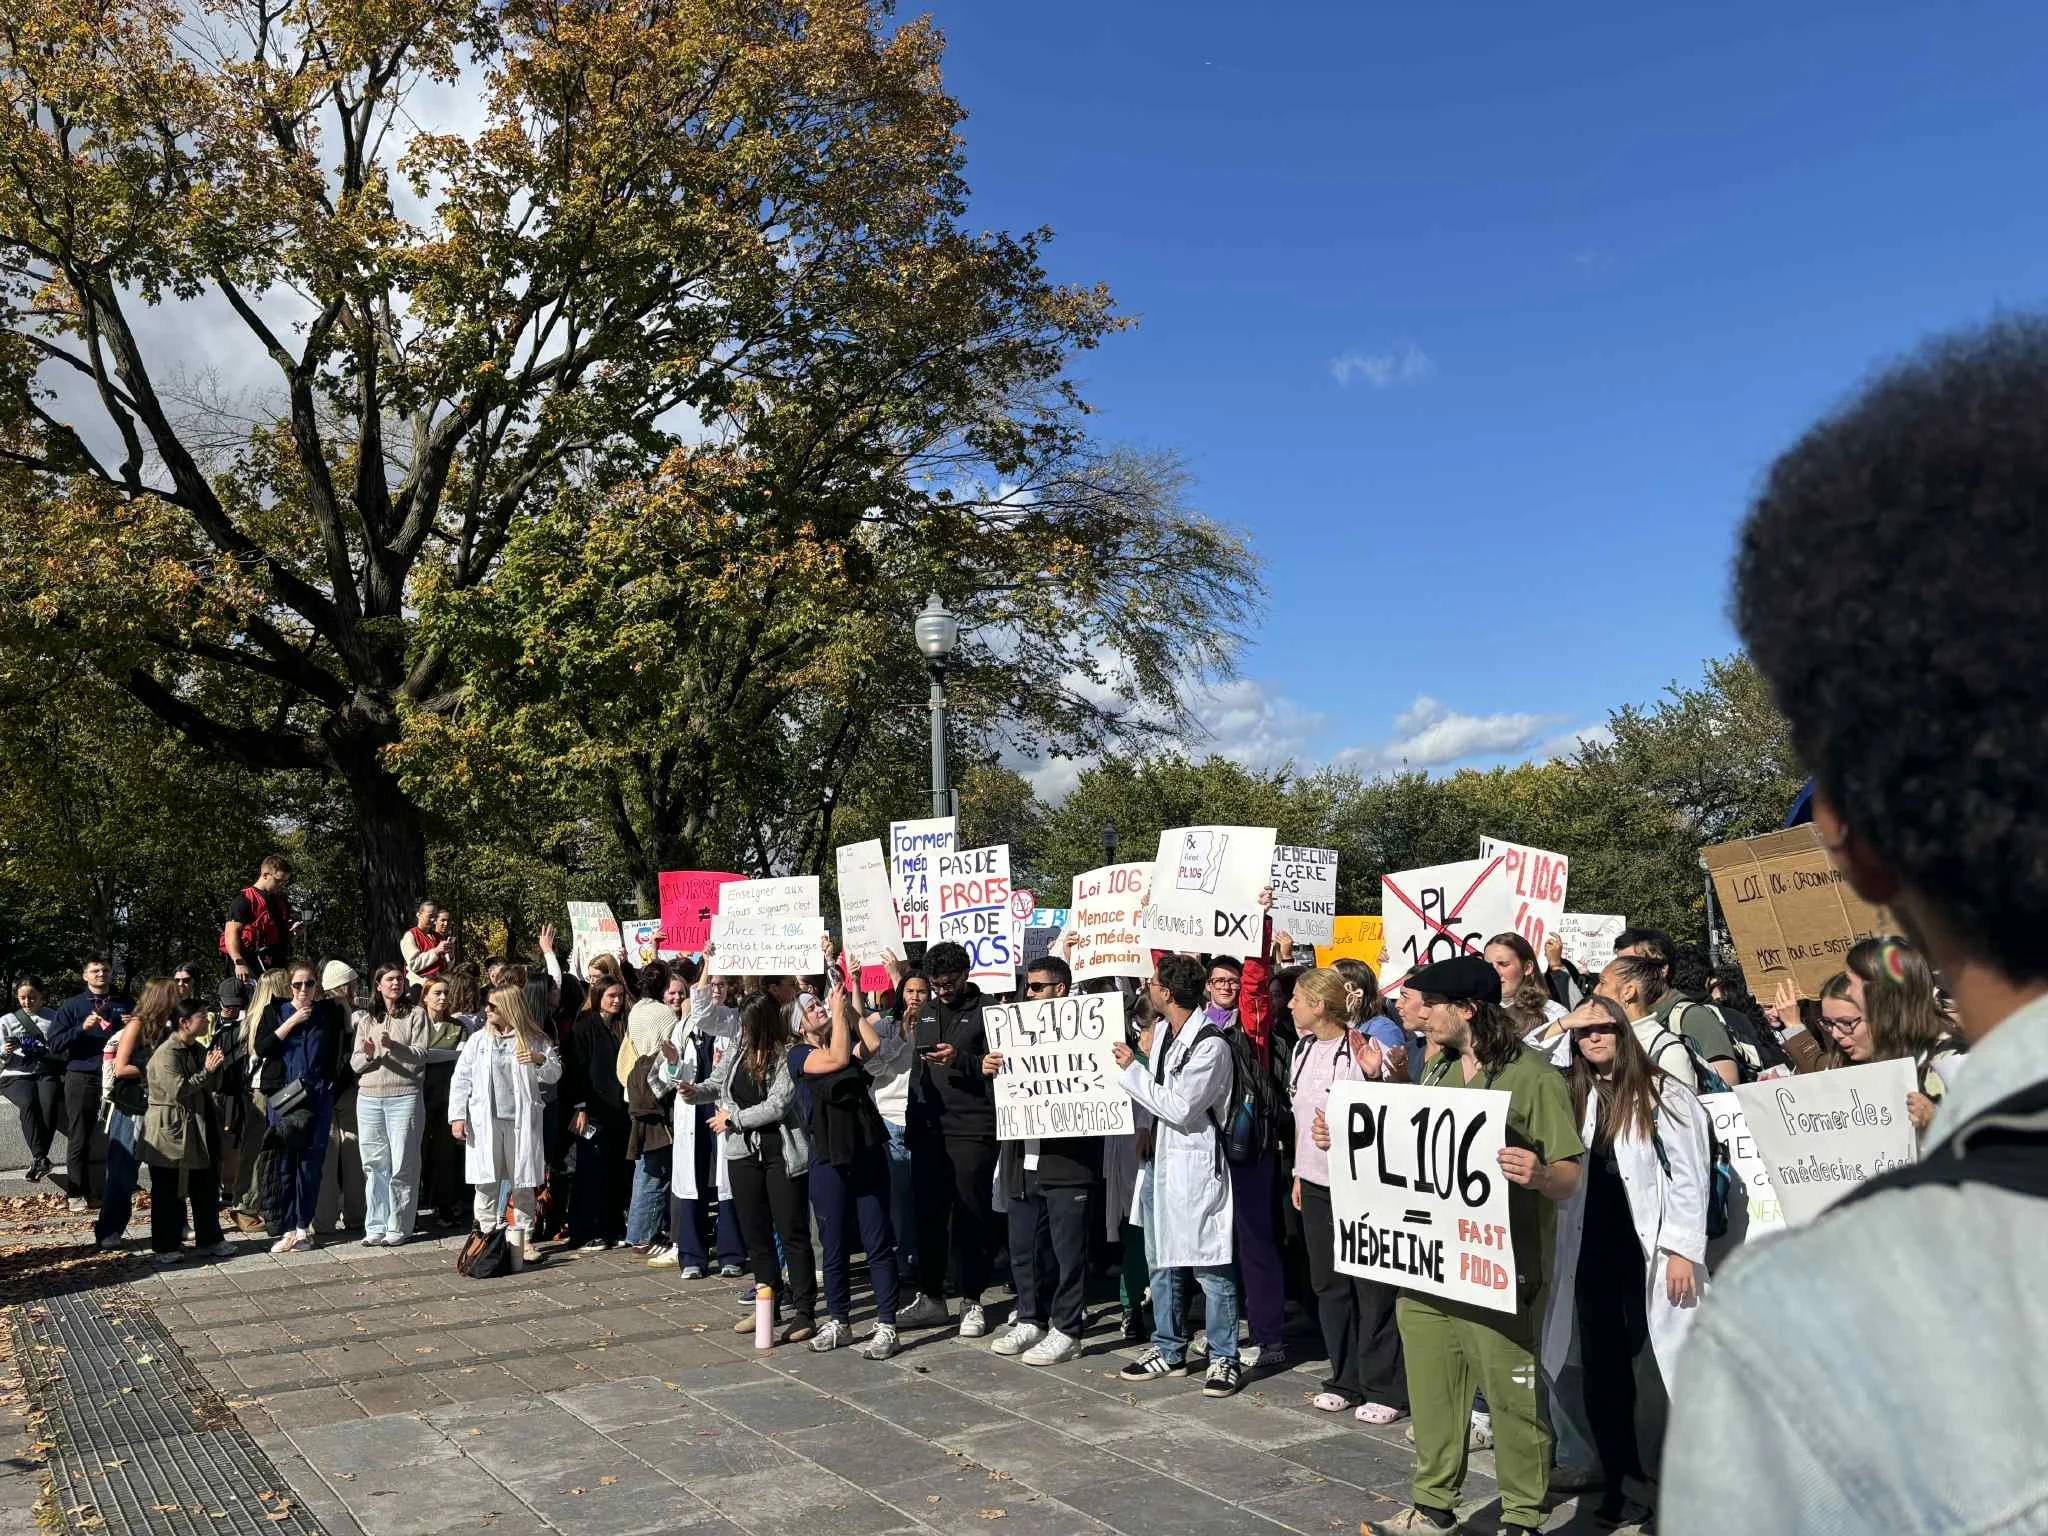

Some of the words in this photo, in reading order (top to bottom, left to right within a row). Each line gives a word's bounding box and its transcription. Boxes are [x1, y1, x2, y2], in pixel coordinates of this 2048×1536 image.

[939, 853, 972, 877] PAS
[975, 850, 998, 873] DE
[1285, 865, 1327, 881] GERE
[940, 878, 1009, 912] PROFS
[1079, 880, 1101, 900] Loi
[1108, 869, 1142, 894] 106
[1272, 879, 1300, 893] PAS
[1732, 875, 1764, 903] LOI
[1078, 908, 1125, 929] Menace
[1293, 900, 1335, 916] USINE
[1421, 886, 1463, 930] PL
[722, 920, 754, 936] Avec
[940, 916, 969, 939] PAS
[974, 913, 1000, 934] DE
[718, 954, 810, 970] DRIVE-THRU
[1074, 955, 1085, 970] de
[1089, 950, 1141, 966] demain
[1757, 947, 1782, 969] MORT
[1809, 943, 1824, 957] LE
[1021, 1054, 1060, 1074] VEUT
[1068, 1053, 1098, 1073] DES
[1020, 1076, 1090, 1098] SOINS
[1851, 1088, 1892, 1126] des
[997, 1104, 1019, 1137] PAS
[1024, 1104, 1046, 1136] DES
[1779, 1154, 1867, 1184] médecins
[1339, 1212, 1445, 1284] MÉDECINE
[1458, 1219, 1507, 1250] FAST
[1460, 1252, 1509, 1290] FOOD
